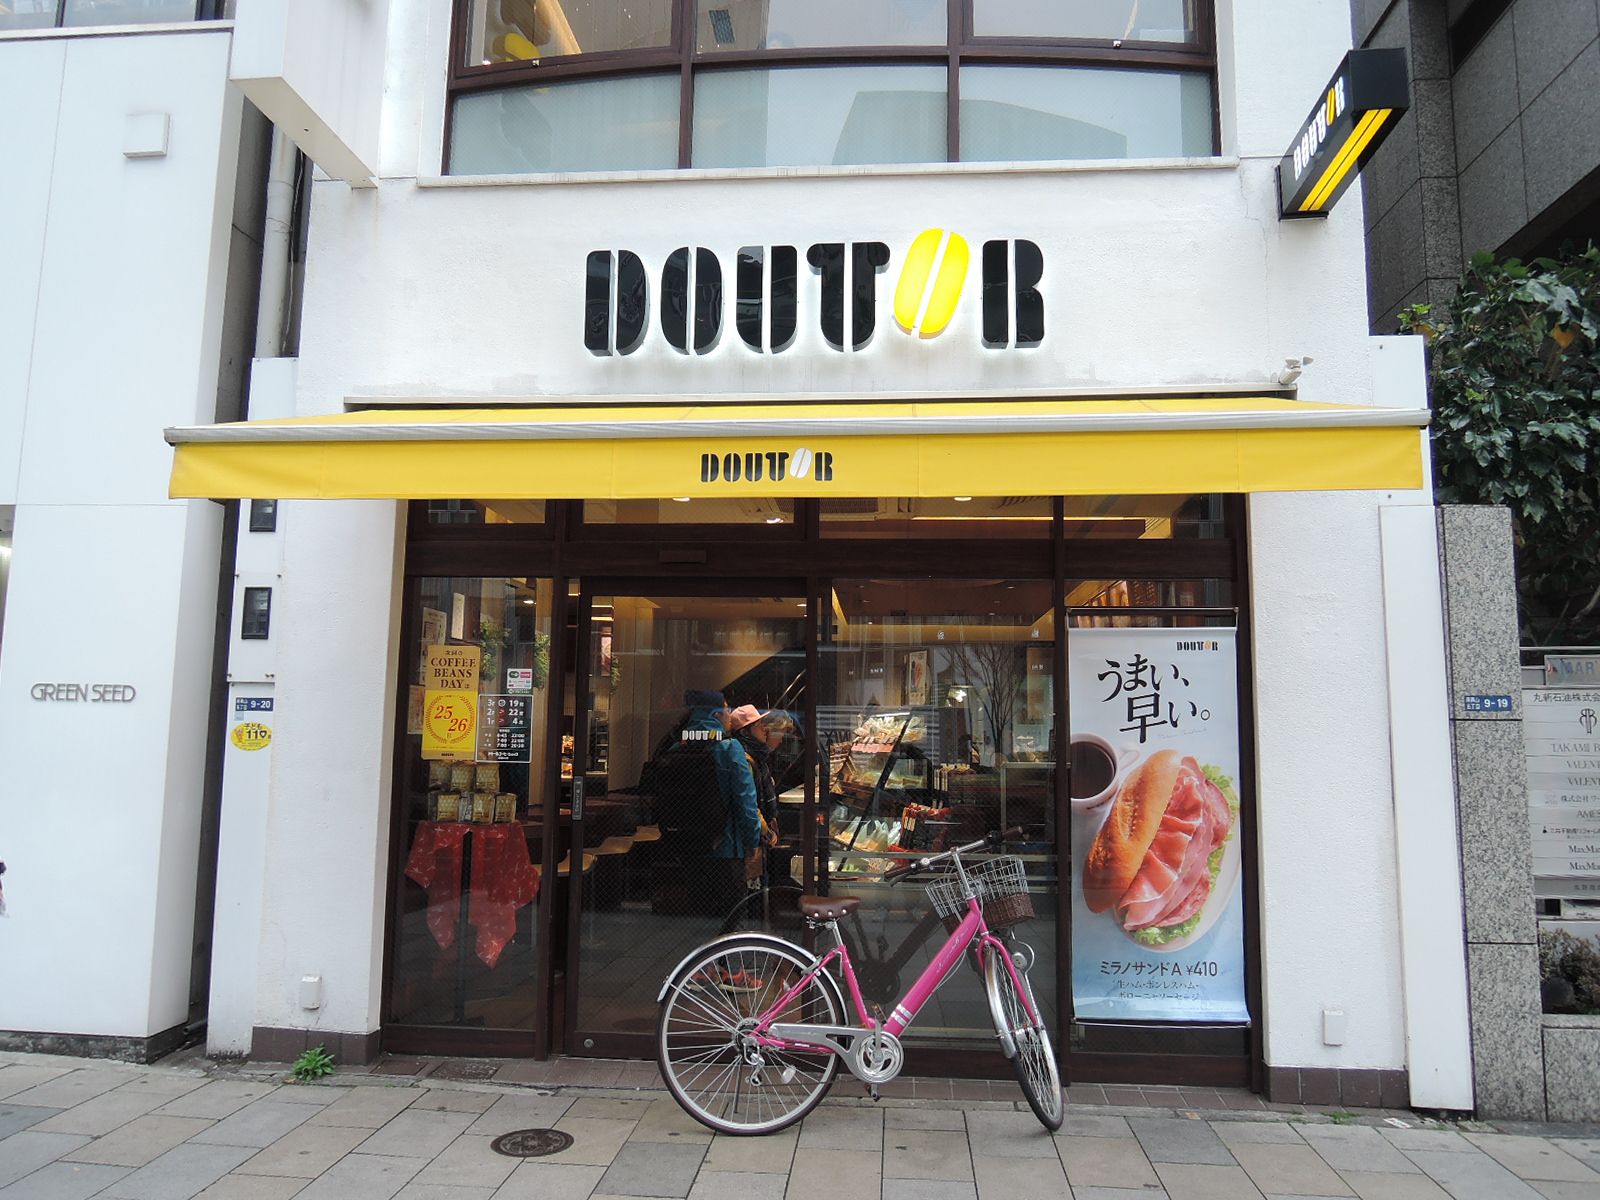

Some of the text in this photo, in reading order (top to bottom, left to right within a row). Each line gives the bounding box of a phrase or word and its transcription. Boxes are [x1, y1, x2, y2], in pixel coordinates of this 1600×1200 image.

[1293, 76, 1345, 181] DOUTOR
[584, 228, 1045, 357] DOUTOR
[700, 447, 833, 483] DOUTOR
[1176, 640, 1218, 651] DOUTOR
[430, 657, 476, 668] COFFEE
[434, 668, 473, 678] BEANS
[1097, 653, 1190, 703] うまい、
[440, 679, 464, 689] DAY
[30, 682, 136, 703] GREEN SEED
[250, 700, 271, 709] 9-20
[1484, 698, 1509, 708] 9-19
[434, 704, 453, 720] 25
[1119, 692, 1211, 744] 早い。
[448, 717, 468, 732] 26
[682, 729, 723, 741] DOUTOR
